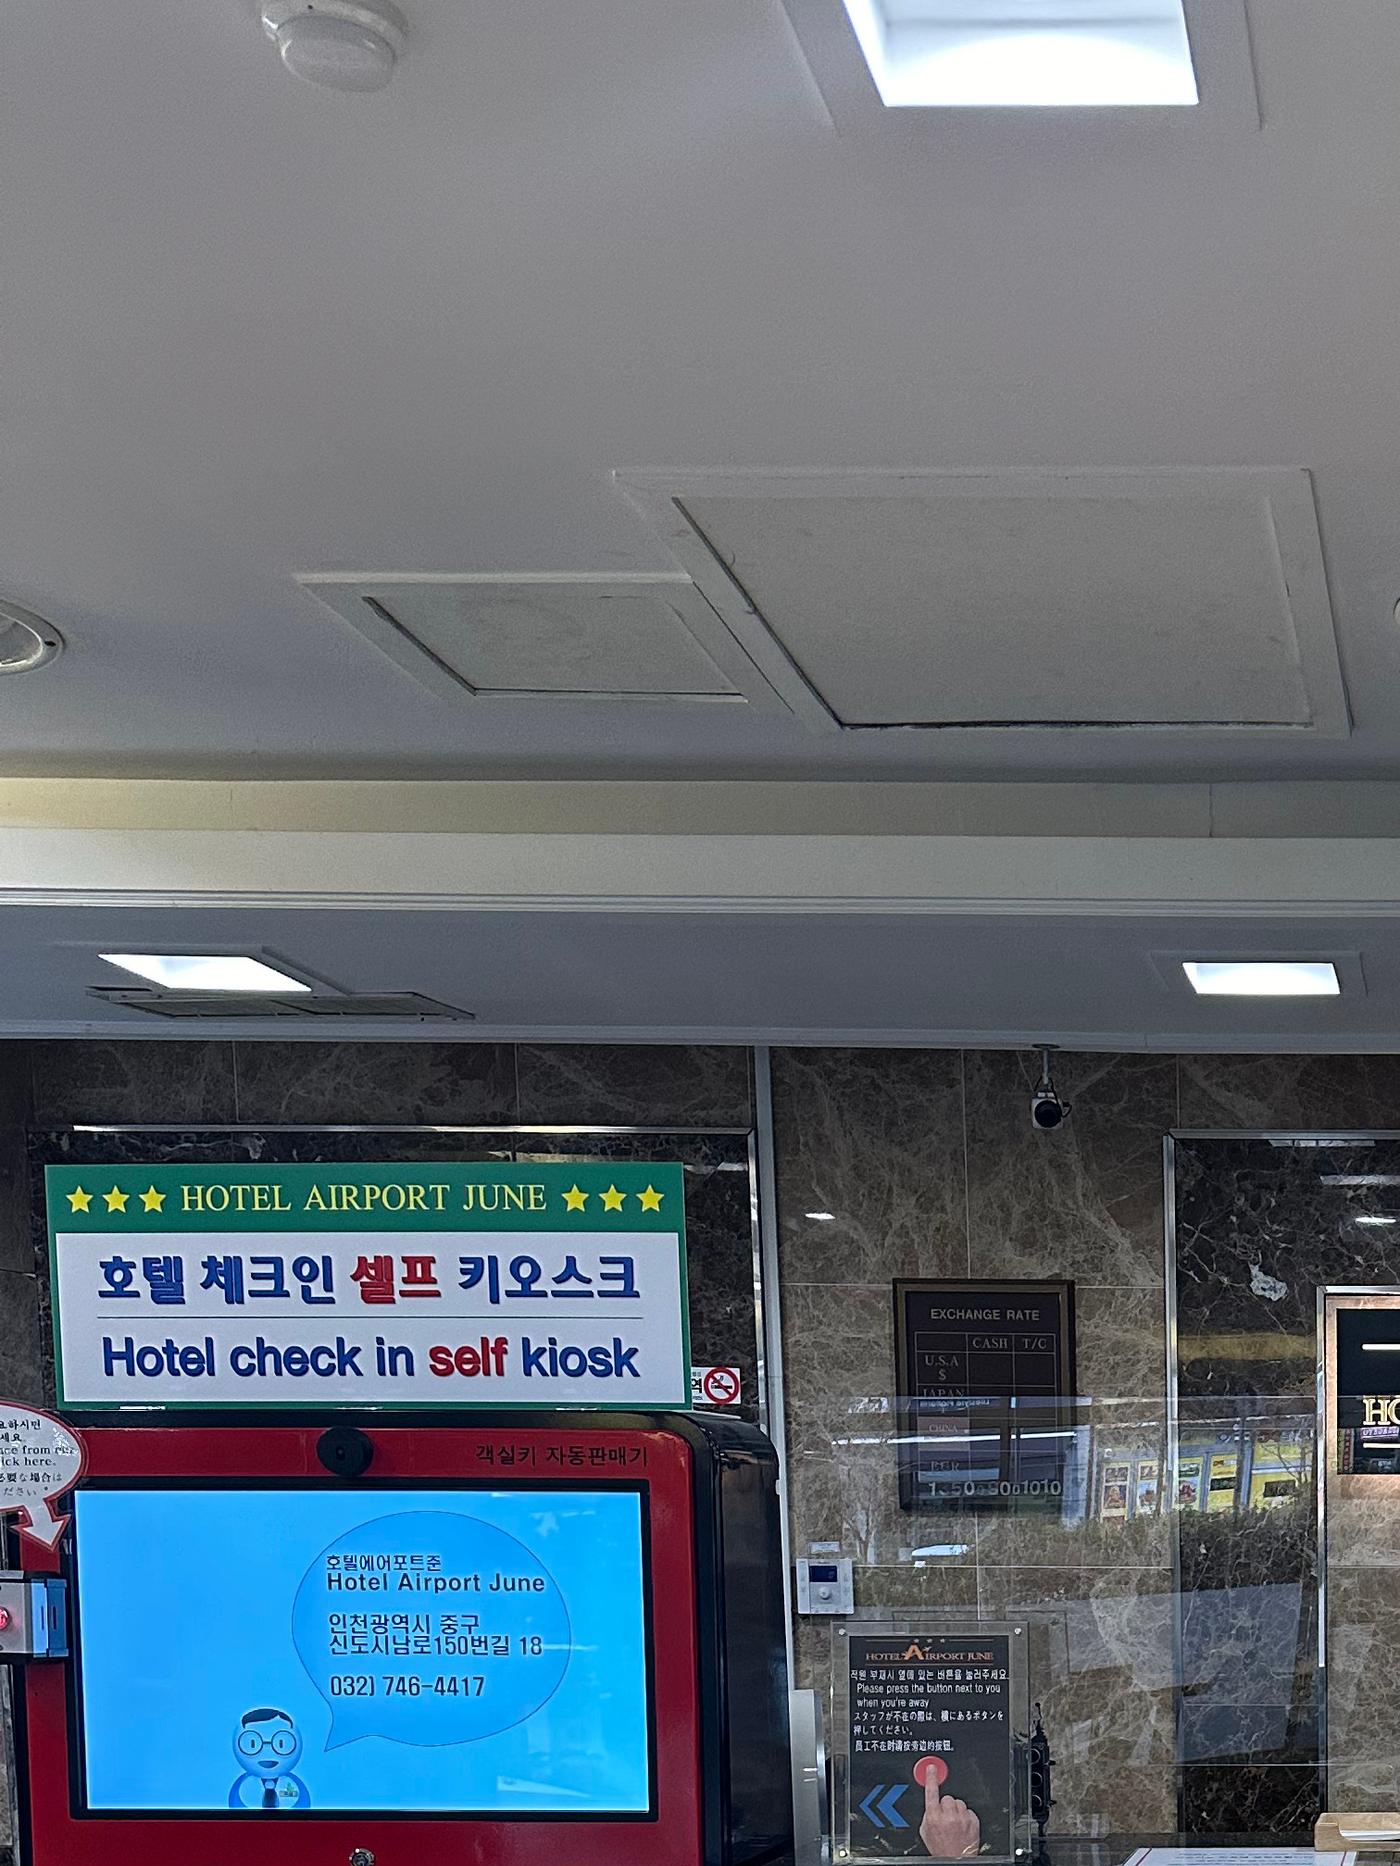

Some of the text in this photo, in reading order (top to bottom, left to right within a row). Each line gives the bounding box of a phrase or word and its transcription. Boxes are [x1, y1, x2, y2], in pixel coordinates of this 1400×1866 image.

[180, 1184, 547, 1211] HOTEL AIRPORT JUNE
[98, 1255, 641, 1305] 호텔 체크인 셀프 키오스크
[930, 1309, 1040, 1321] EXCHANGE RATE
[972, 1338, 1008, 1349] CASH
[103, 1336, 641, 1378] Hotel check in self kiosk
[22, 1445, 50, 1455] from
[476, 1445, 648, 1467] 객실키 자동판매기
[326, 1555, 442, 1571] 호텔에어포트준
[327, 1573, 545, 1594] Hotel Airport June
[328, 1614, 480, 1635] 인천광역시 중구
[328, 1635, 543, 1655] 신도시남로150번길 18
[967, 1652, 994, 1661] JUNE
[330, 1676, 485, 1696] 032) 746-4417
[856, 1683, 1001, 1694] Please press the button next to you
[856, 1697, 930, 1708] when you're away
